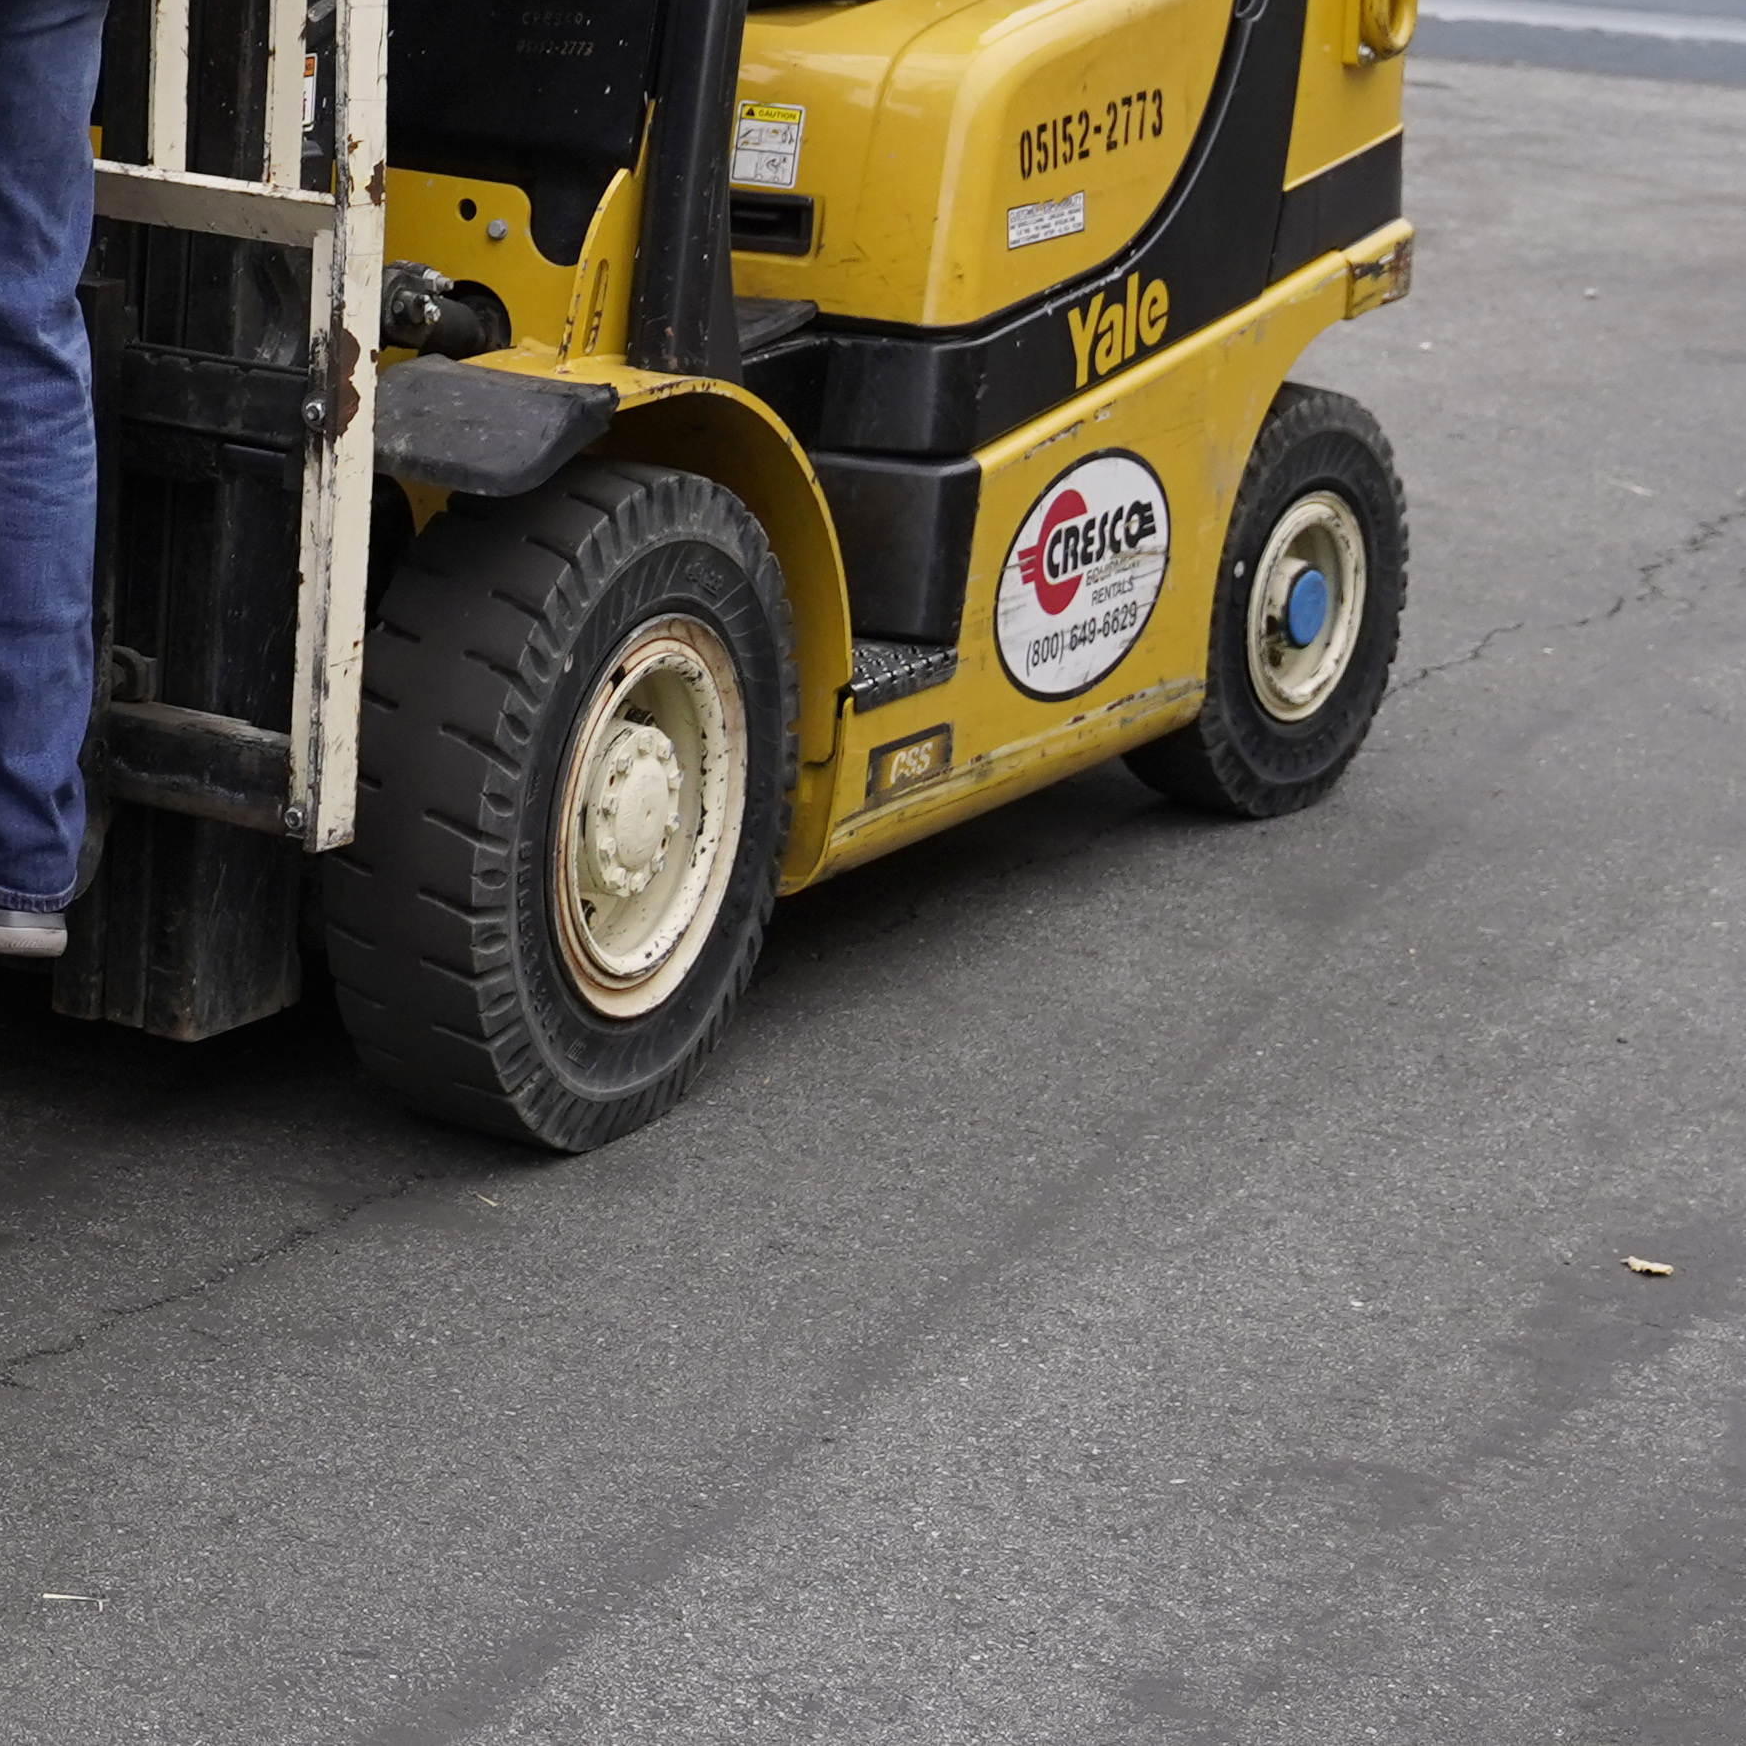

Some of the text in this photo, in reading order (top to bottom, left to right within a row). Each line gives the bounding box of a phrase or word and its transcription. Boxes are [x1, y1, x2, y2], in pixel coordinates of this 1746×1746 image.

[758, 109, 797, 121] CAUTION
[1019, 88, 1163, 180] 05152-2773
[1067, 271, 1170, 389] Yale
[1046, 500, 1156, 579] CRESCO
[1091, 575, 1134, 606] RENTALS
[1026, 601, 1137, 677] (800) 649-6629
